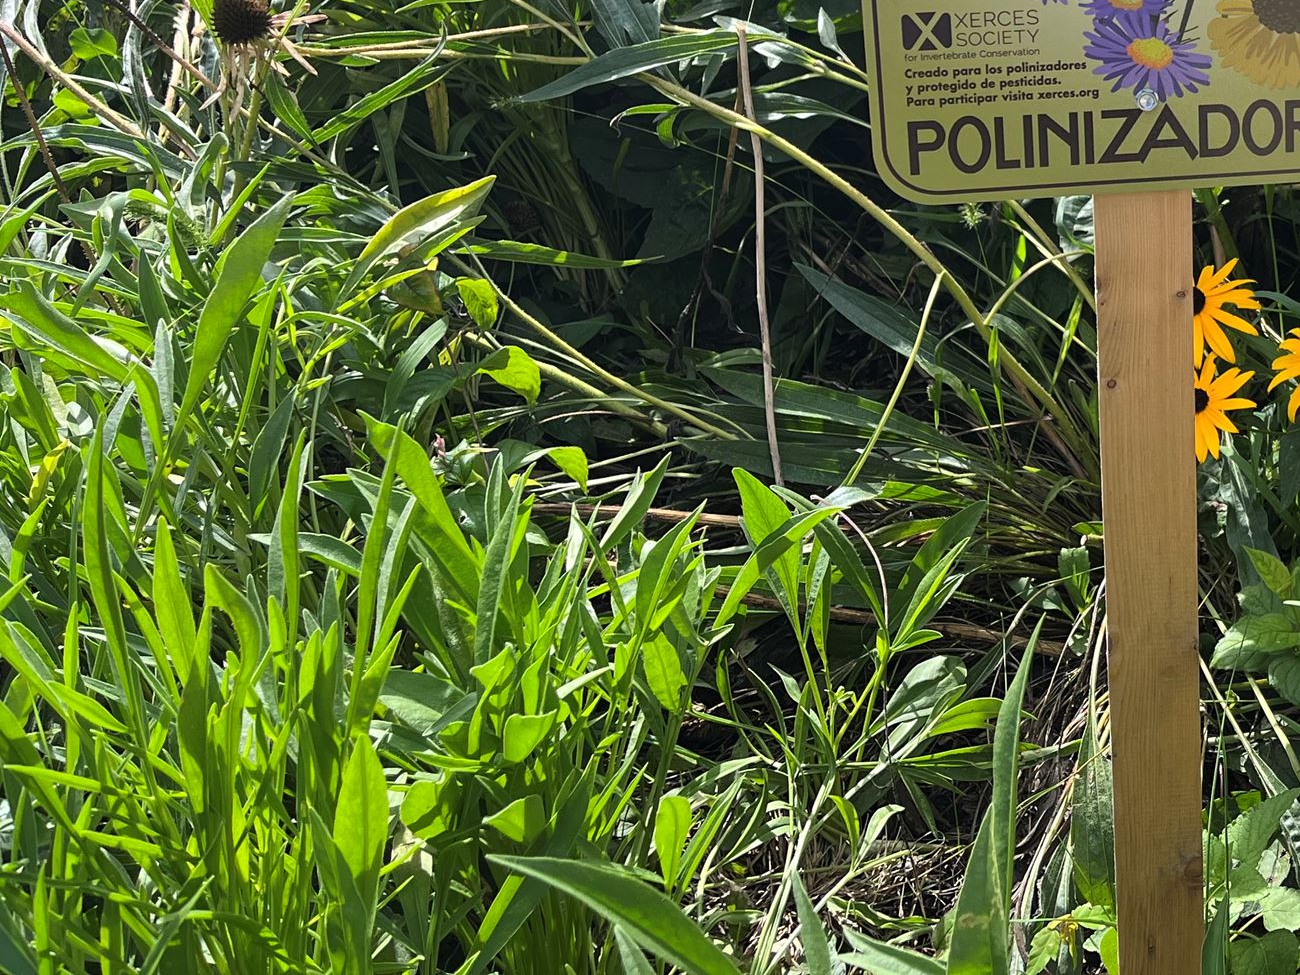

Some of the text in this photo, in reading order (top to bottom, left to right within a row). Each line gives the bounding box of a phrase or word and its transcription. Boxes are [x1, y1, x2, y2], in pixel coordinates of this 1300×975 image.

[954, 9, 1040, 29] XERCES
[956, 29, 1040, 48] SOCIETY
[904, 48, 1041, 63] for Invertebrate Conservation
[904, 59, 1088, 80] Creado para los polinizadores
[905, 75, 1062, 96] y protegido de pesticidas.
[906, 87, 1100, 108] Para participar visita xerces.org
